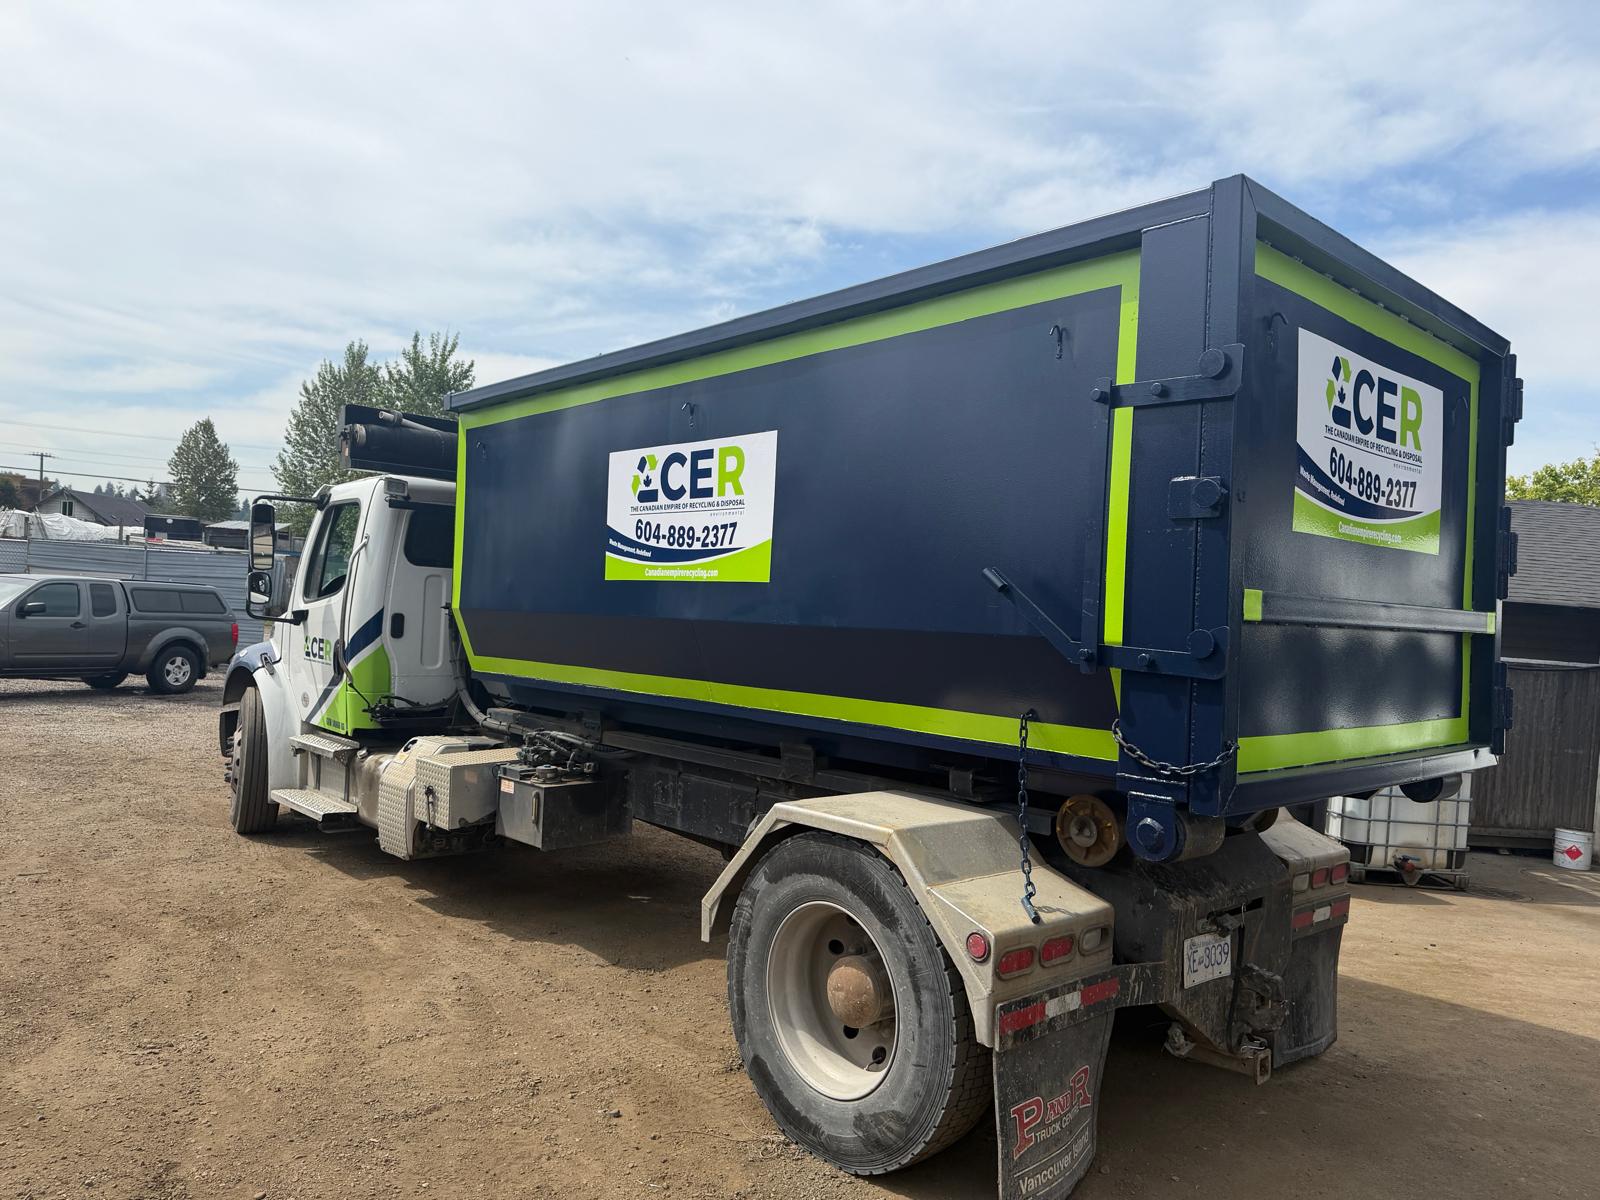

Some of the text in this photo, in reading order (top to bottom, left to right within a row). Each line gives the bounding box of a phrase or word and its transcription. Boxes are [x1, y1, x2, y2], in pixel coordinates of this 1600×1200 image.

[1325, 425, 1334, 436] THE
[1334, 427, 1355, 442] CANADIAN
[1355, 434, 1369, 449] EMPIRE
[1375, 443, 1399, 457] RECYCLING
[1402, 451, 1423, 464] DISPOSAL
[1329, 446, 1417, 509] 604-889-2377
[639, 504, 664, 512] CANADIAN
[663, 503, 682, 511] EMPIRE
[681, 502, 689, 510] OF
[689, 500, 716, 509] RECYCLING
[720, 499, 745, 507] DISPOSAL
[635, 518, 738, 548] 604-889-2377
[1010, 1096, 1044, 1160] P
[1070, 1065, 1092, 1109] R
[1035, 1121, 1061, 1143] TRUCK
[1019, 1151, 1072, 1195] Vancouver
